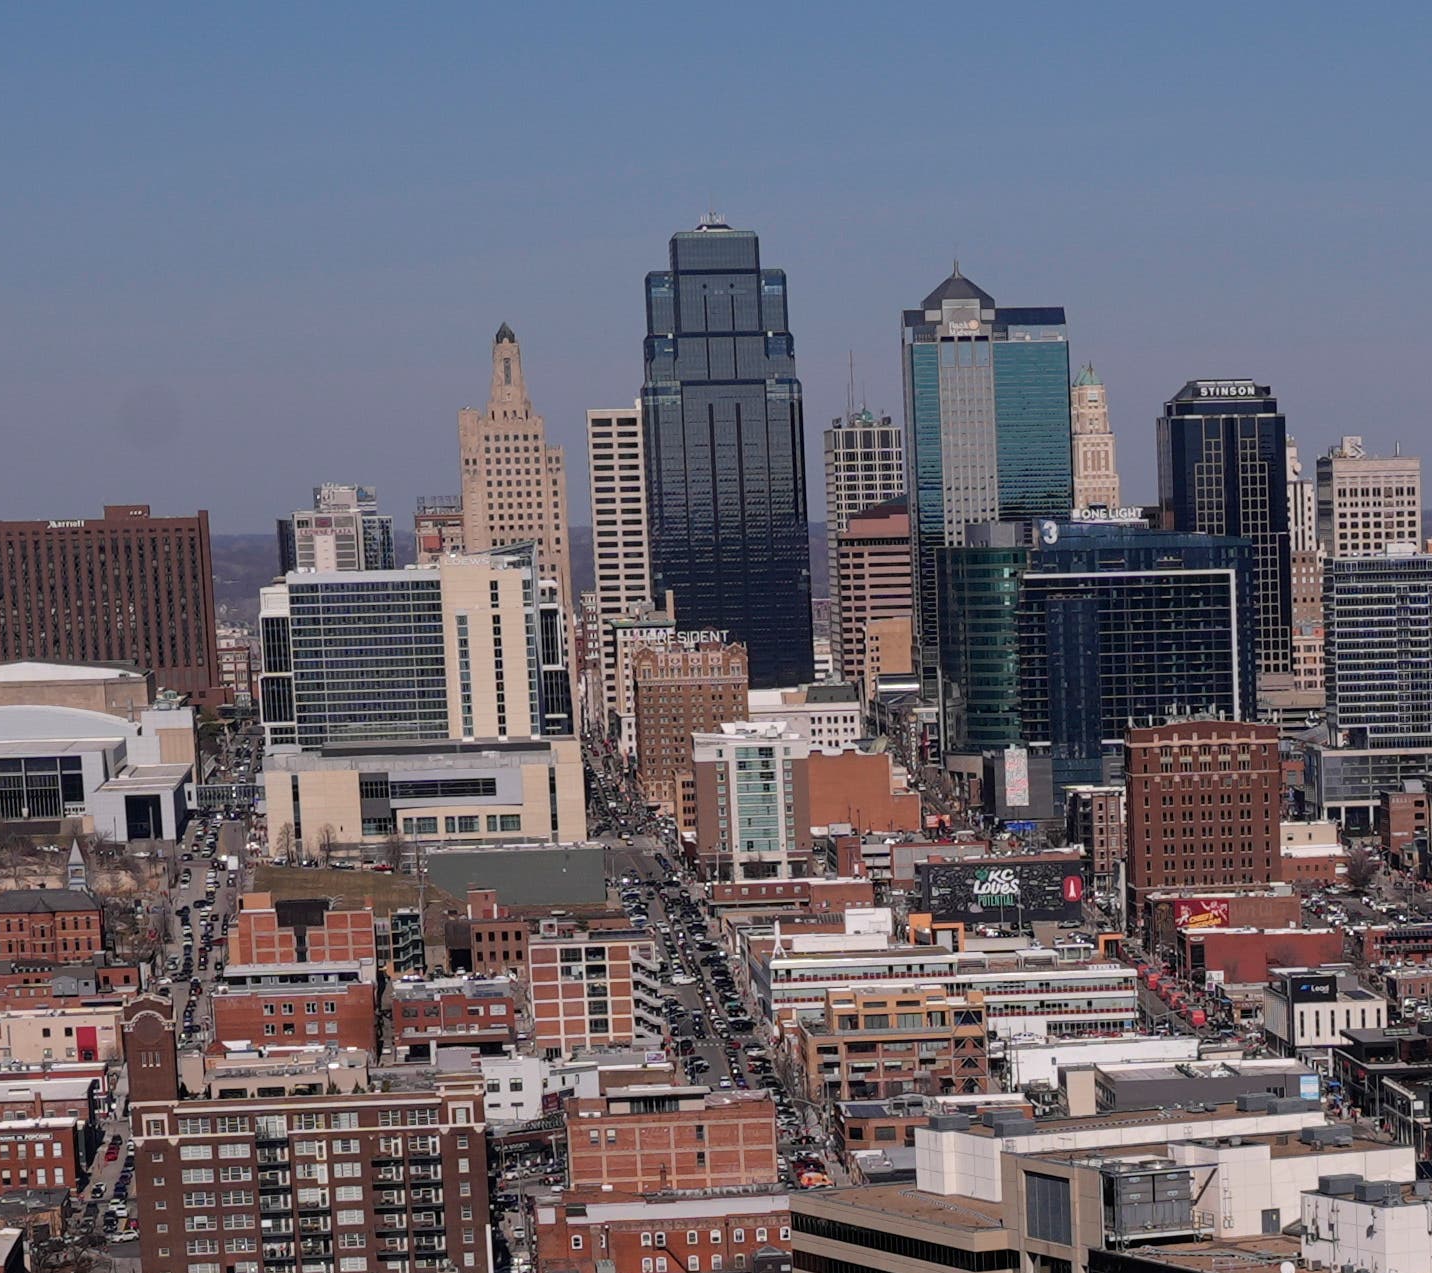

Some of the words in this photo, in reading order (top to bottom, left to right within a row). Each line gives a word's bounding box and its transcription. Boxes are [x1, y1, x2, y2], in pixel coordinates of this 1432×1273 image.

[1200, 386, 1255, 397] STINSON
[1080, 508, 1109, 521] ONE
[1109, 507, 1144, 520] LIGHT
[47, 519, 85, 529] Marriott
[1043, 521, 1058, 544] 3
